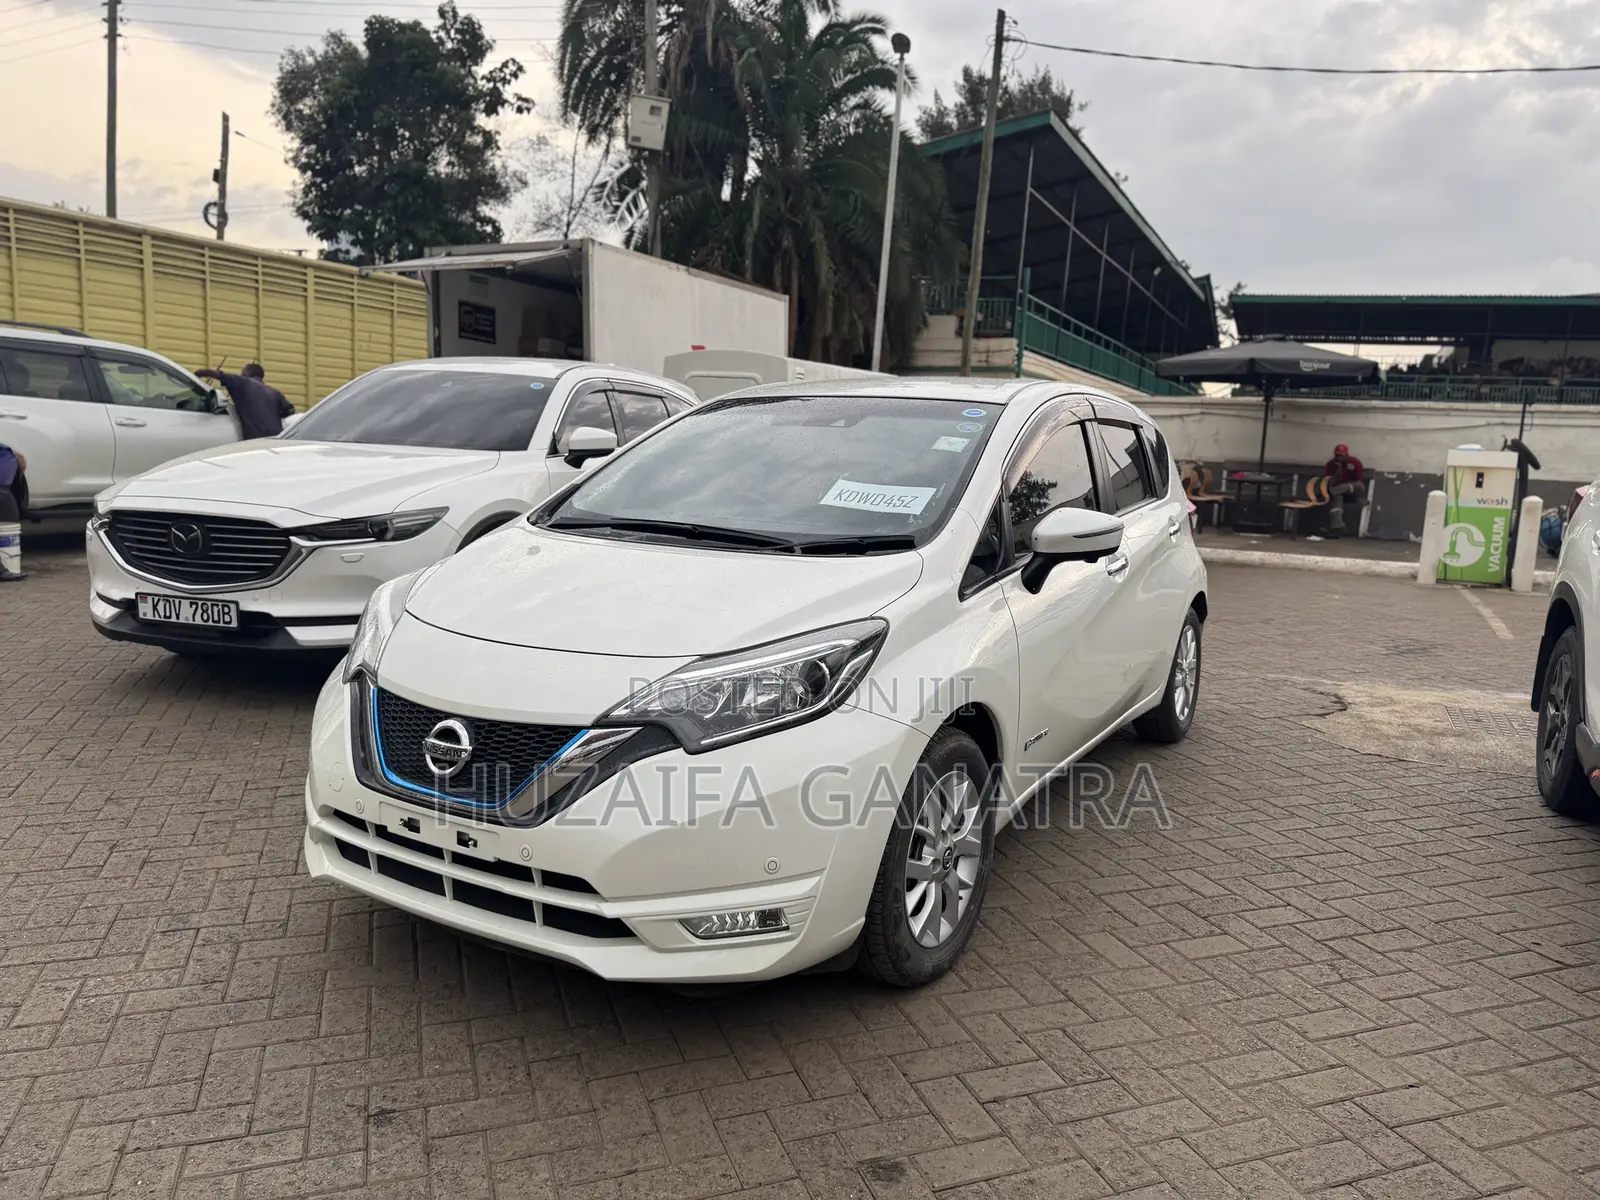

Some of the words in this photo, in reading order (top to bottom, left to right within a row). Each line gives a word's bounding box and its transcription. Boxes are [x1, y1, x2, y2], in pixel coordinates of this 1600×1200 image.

[1299, 359, 1332, 371] bonjour
[1476, 496, 1508, 506] wash
[1488, 516, 1506, 572] VACUUM
[151, 597, 182, 620] KDV
[189, 600, 233, 625] 780B
[423, 740, 463, 758] NISSAN
